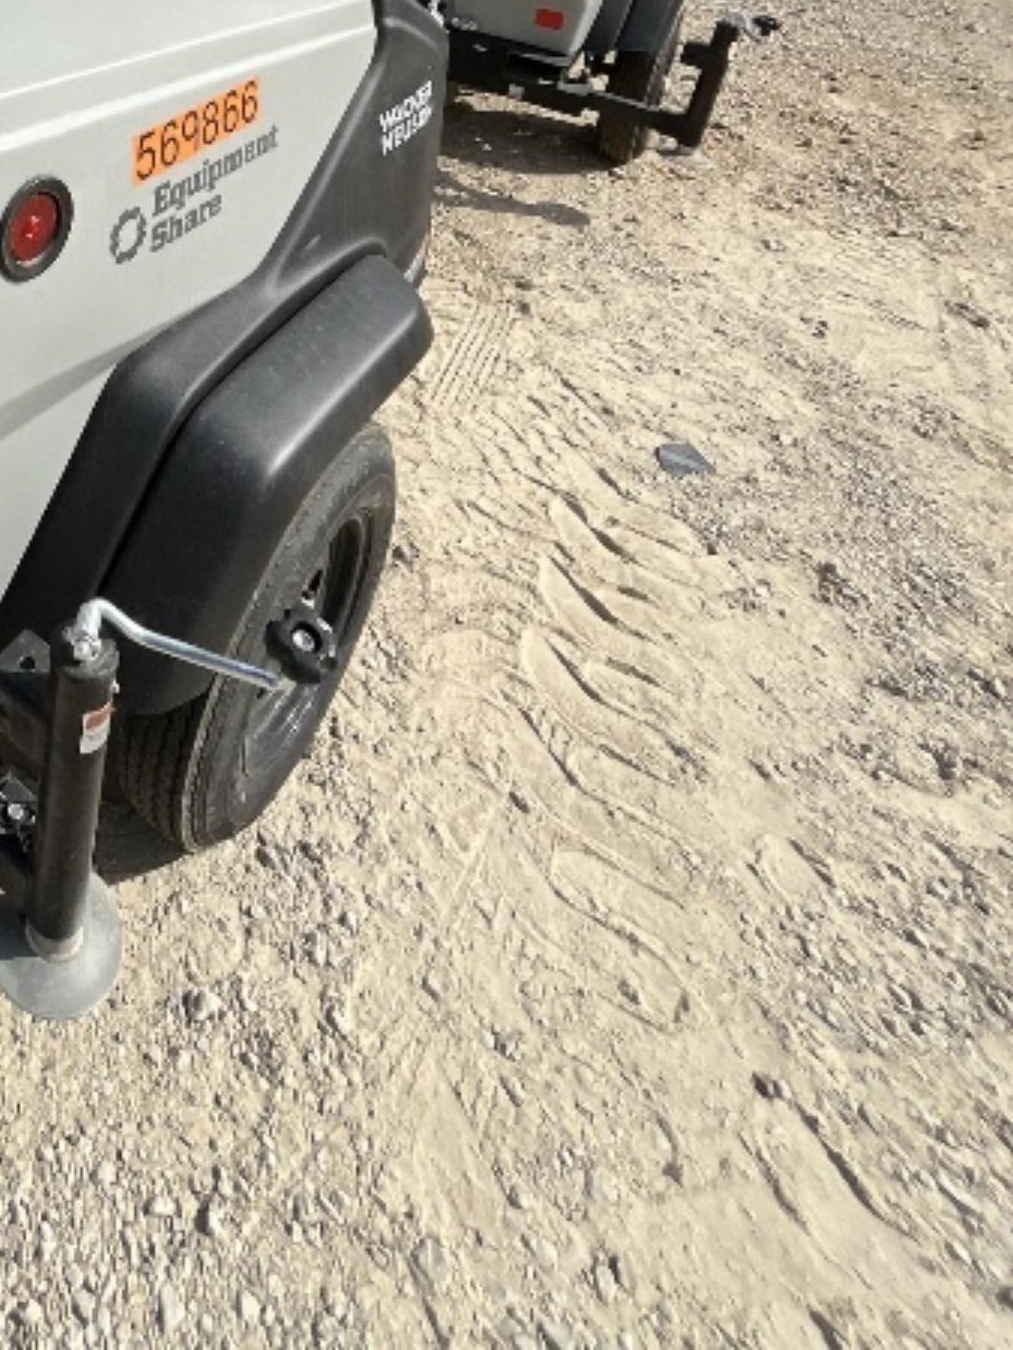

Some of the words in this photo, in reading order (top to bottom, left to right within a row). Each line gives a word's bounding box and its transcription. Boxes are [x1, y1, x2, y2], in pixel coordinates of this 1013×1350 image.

[135, 79, 259, 181] 569866
[152, 124, 280, 217] Equipment
[149, 194, 223, 253] Share
